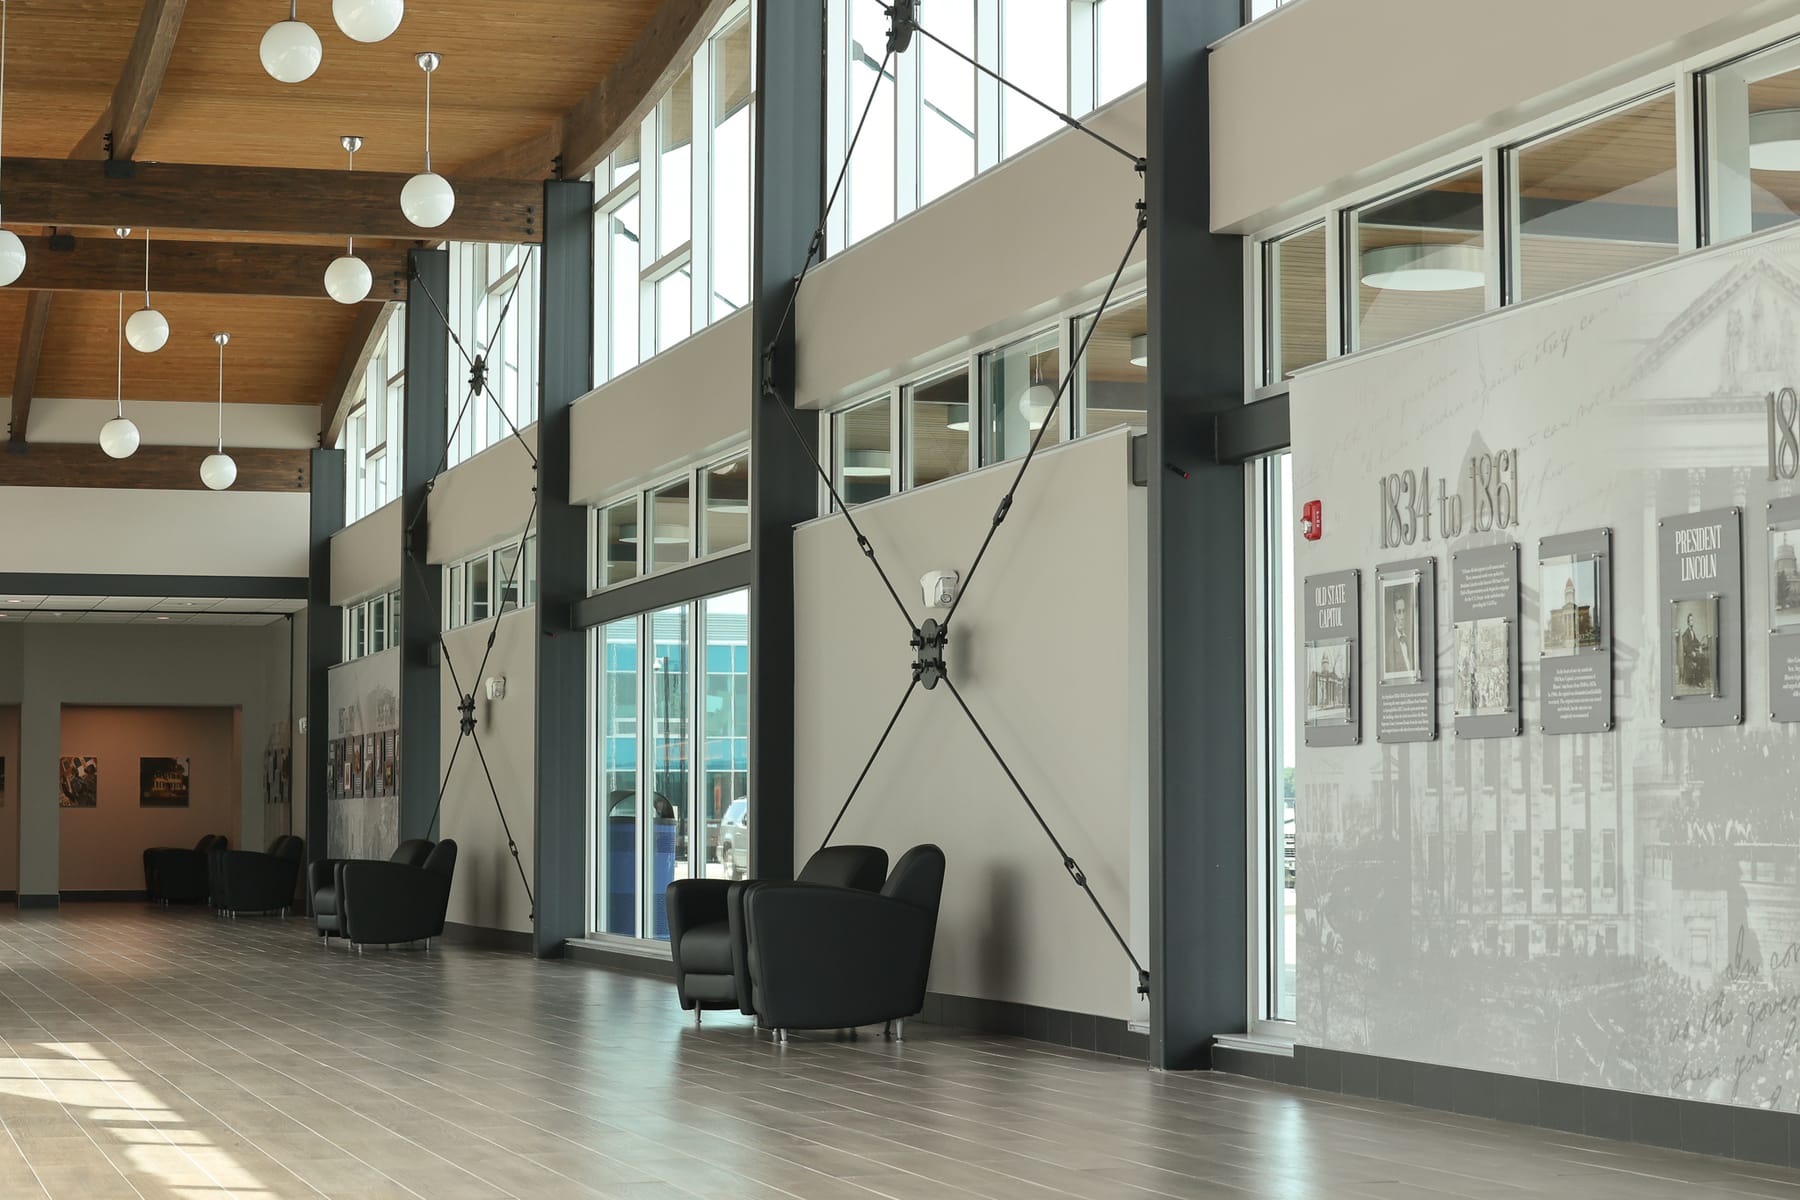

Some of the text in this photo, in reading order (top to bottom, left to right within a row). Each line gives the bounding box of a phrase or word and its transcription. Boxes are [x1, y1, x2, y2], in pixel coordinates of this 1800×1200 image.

[1765, 387, 1800, 482] 18
[1379, 466, 1432, 549] 1834
[1437, 477, 1463, 540] to
[1469, 448, 1519, 534] 1861
[1675, 524, 1723, 555] PRESIDENT
[1681, 553, 1717, 582] LINCOLN
[1315, 583, 1346, 607] OLD STATE
[1319, 607, 1343, 629] CAPITOL
